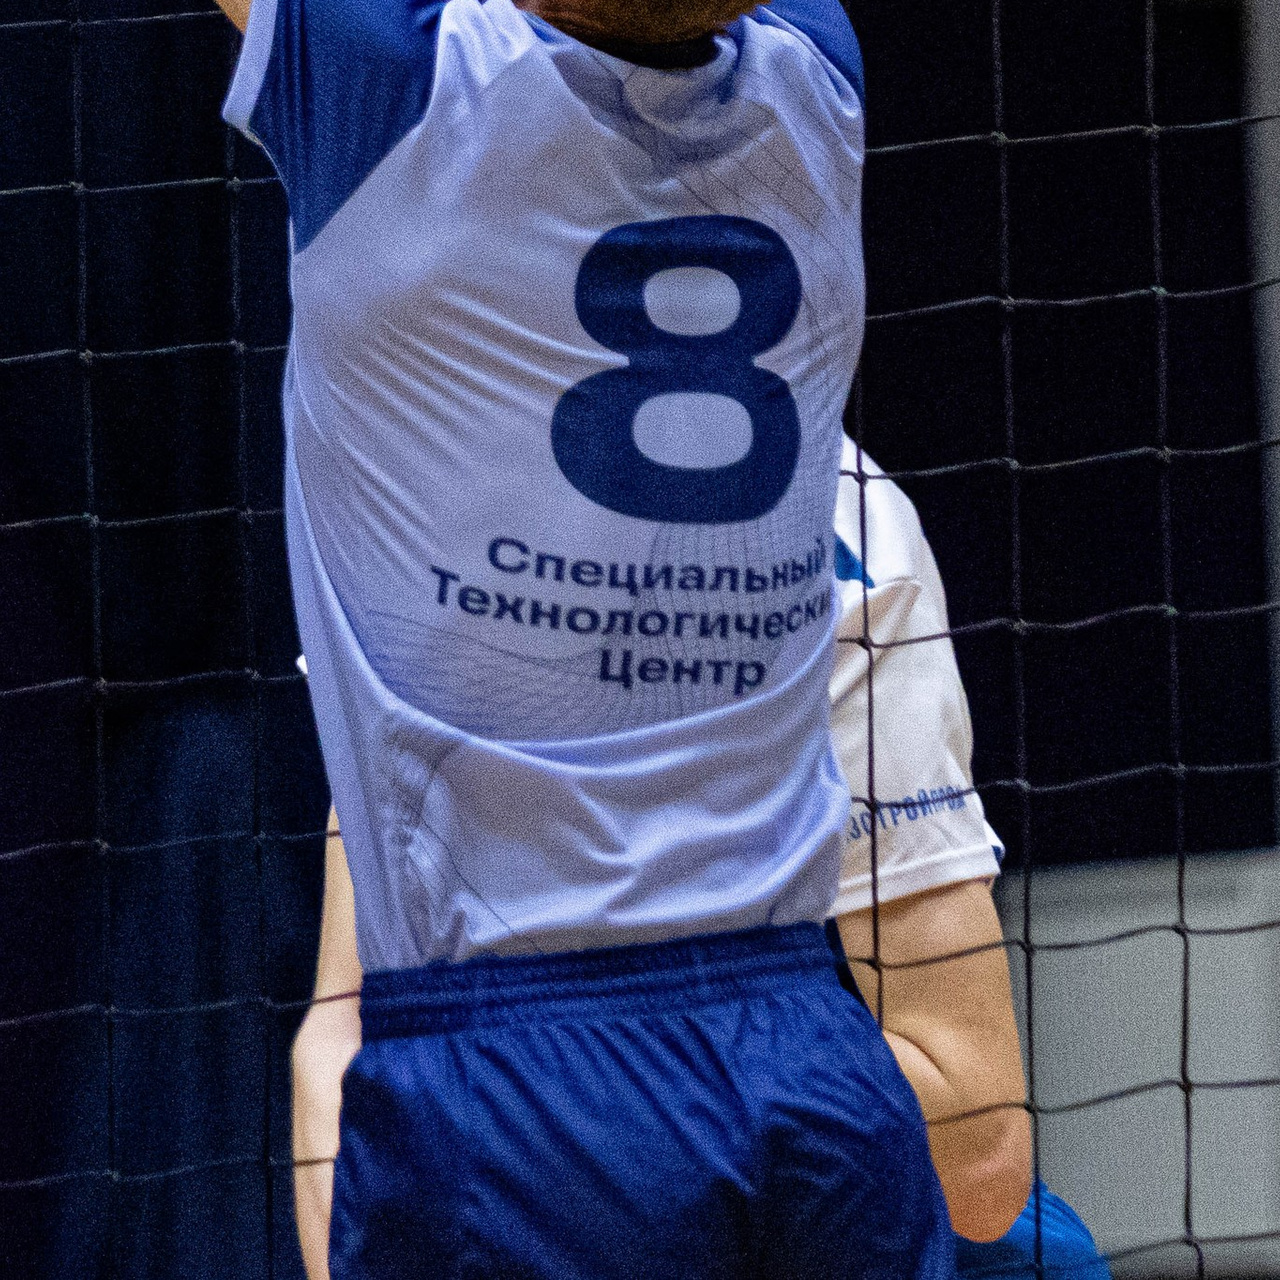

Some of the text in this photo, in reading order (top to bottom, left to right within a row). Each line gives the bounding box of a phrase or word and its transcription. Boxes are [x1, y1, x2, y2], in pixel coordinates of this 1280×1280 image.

[551, 214, 802, 525] 8
[487, 536, 827, 597] Специальный
[429, 564, 832, 641] Технологически
[599, 649, 767, 697] Центр
